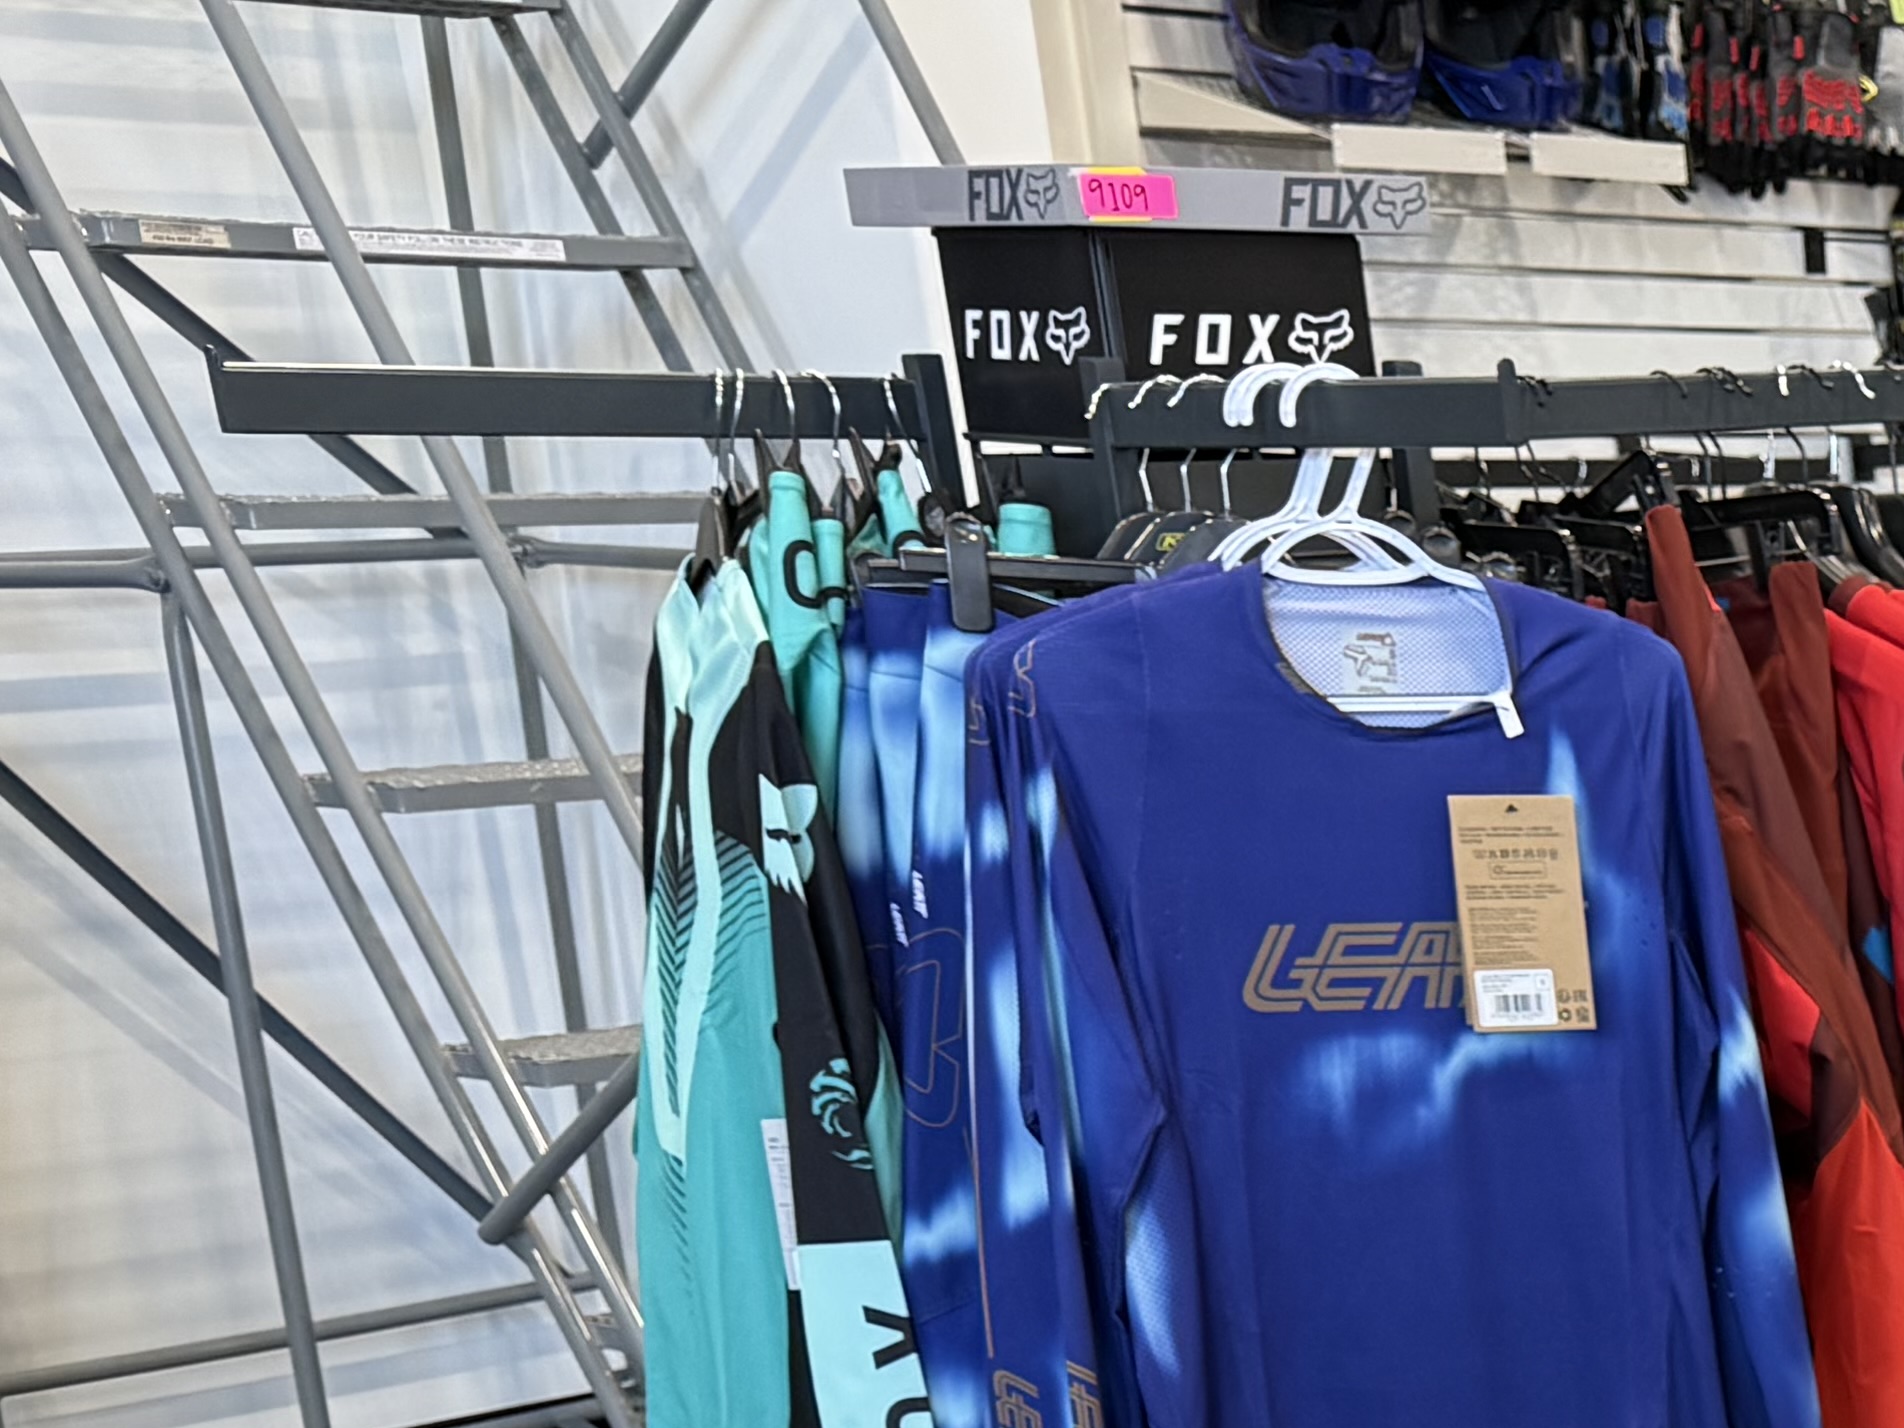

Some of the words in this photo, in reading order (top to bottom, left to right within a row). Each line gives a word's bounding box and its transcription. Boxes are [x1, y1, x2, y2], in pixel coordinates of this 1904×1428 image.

[967, 169, 1024, 222] FOX
[1088, 179, 1149, 212] 9109
[1281, 177, 1370, 229] FOX
[964, 309, 1039, 362] FOX
[1149, 313, 1281, 365] FOX
[1243, 921, 1460, 1013] LEA
